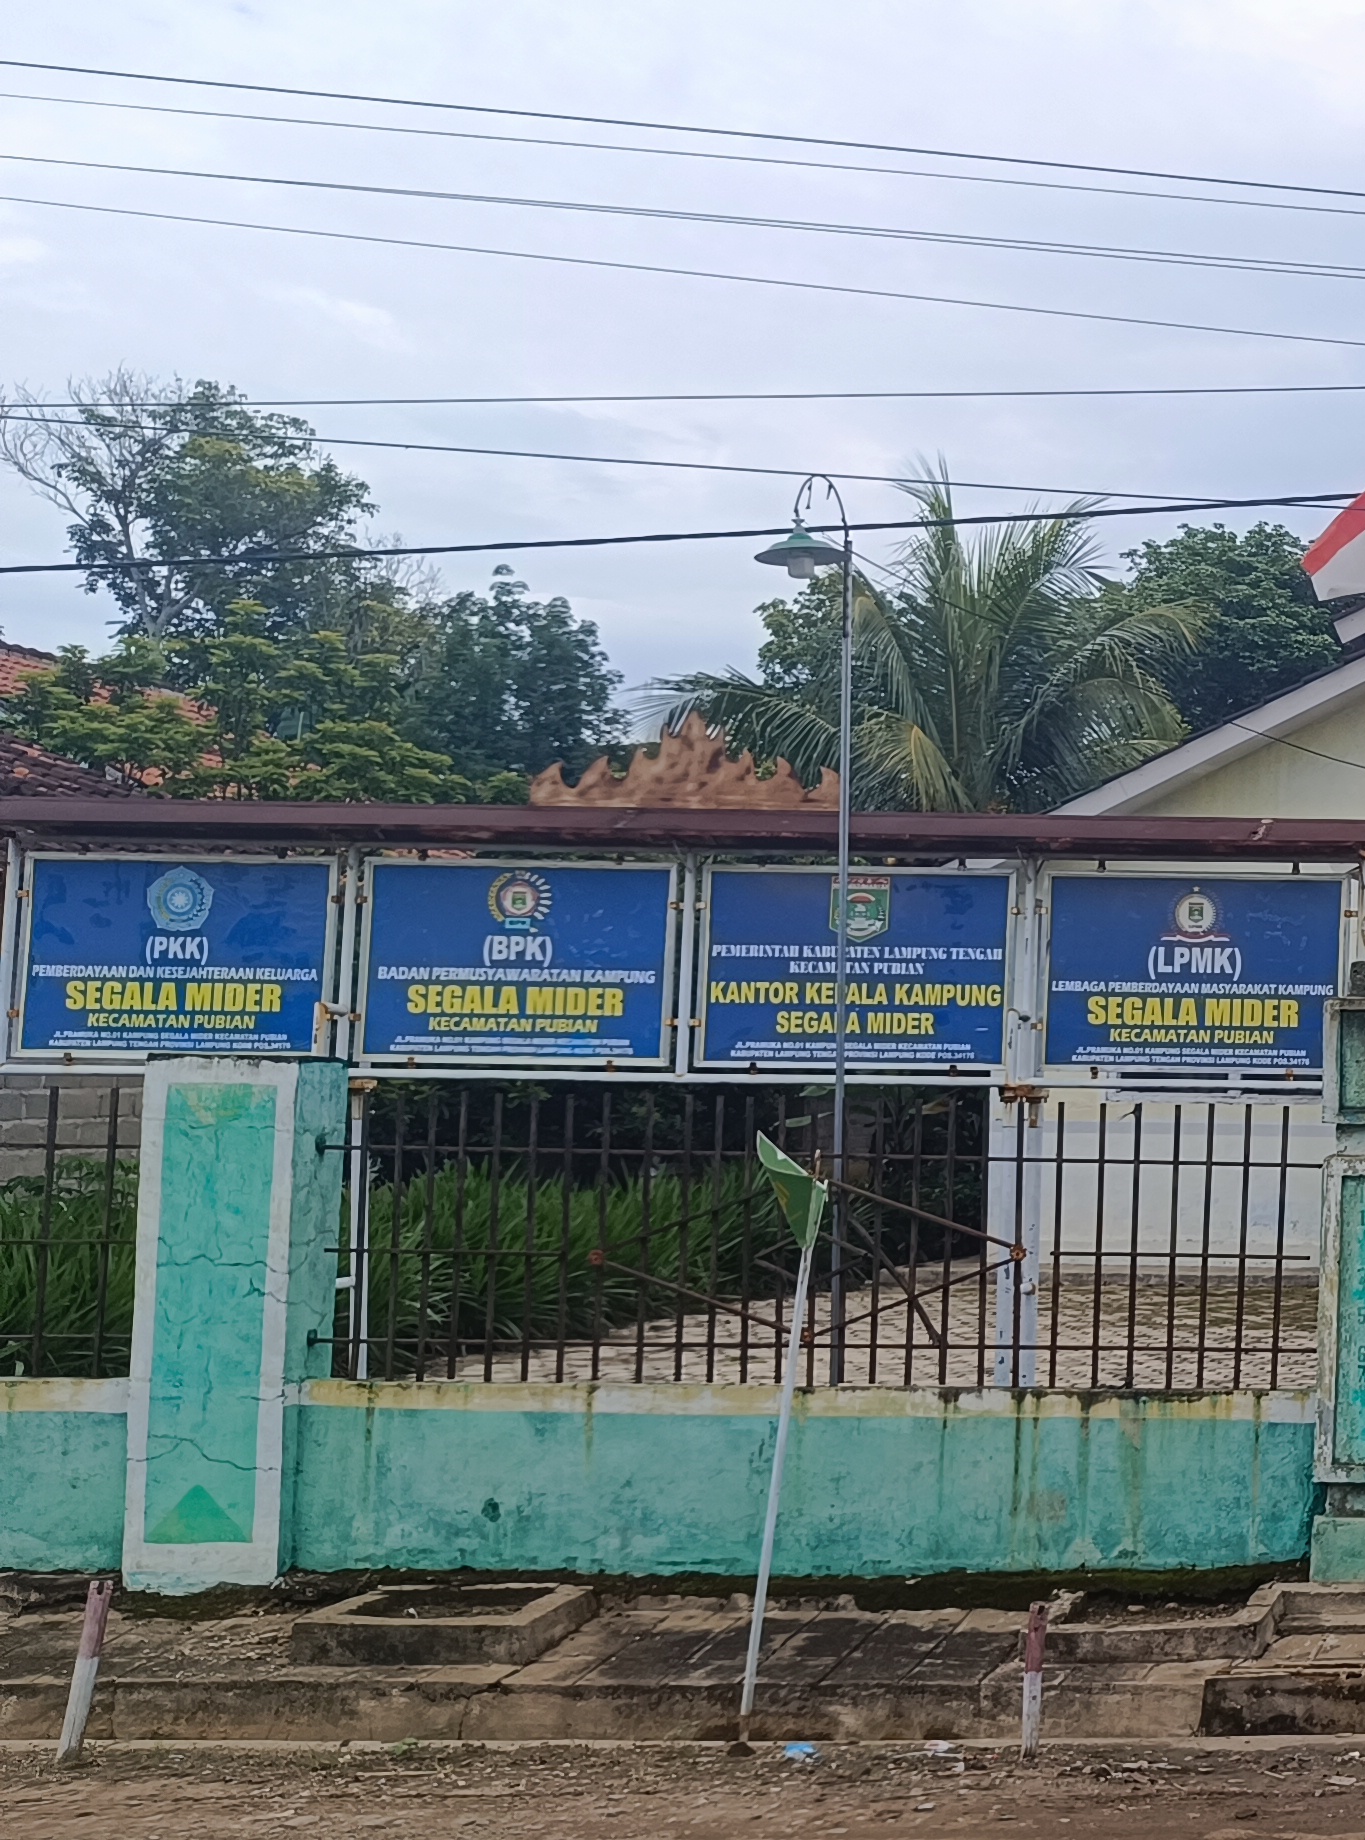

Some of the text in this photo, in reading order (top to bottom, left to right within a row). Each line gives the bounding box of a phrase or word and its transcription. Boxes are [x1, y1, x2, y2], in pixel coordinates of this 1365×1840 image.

[145, 936, 209, 964] (PKK)
[483, 935, 553, 966] (BPK)
[712, 944, 1002, 961] PEMERINTAH KABUATEN LAMPUNG TENGAH
[32, 965, 318, 981] PEMBERDAYAAN DAN KESEJAHTERAAN KELUARGA
[790, 960, 925, 975] KECAMTAN PUBIAN
[1148, 946, 1242, 981] (LPMK)
[377, 966, 656, 984] BADAN PERMUSYAWARATAN KAMPUNG
[65, 981, 281, 1012] SEGALA MIDER
[711, 982, 799, 1004] KANTOR
[895, 983, 1001, 1006] KAMPUNG
[1052, 981, 1333, 996] LEMBAGA PEMBERDAYAAN MASYARAKAT KAMPUNG
[407, 984, 624, 1016] SEGALA MIDER
[87, 1013, 255, 1029] KECAMATAN PUBIAN
[1087, 996, 1298, 1027] SEGALA MIDER
[428, 1016, 598, 1033] KECAMATAN PUBIAN
[867, 1012, 934, 1035] MIDER
[1110, 1029, 1274, 1044] KECAMATAN PUBIAN
